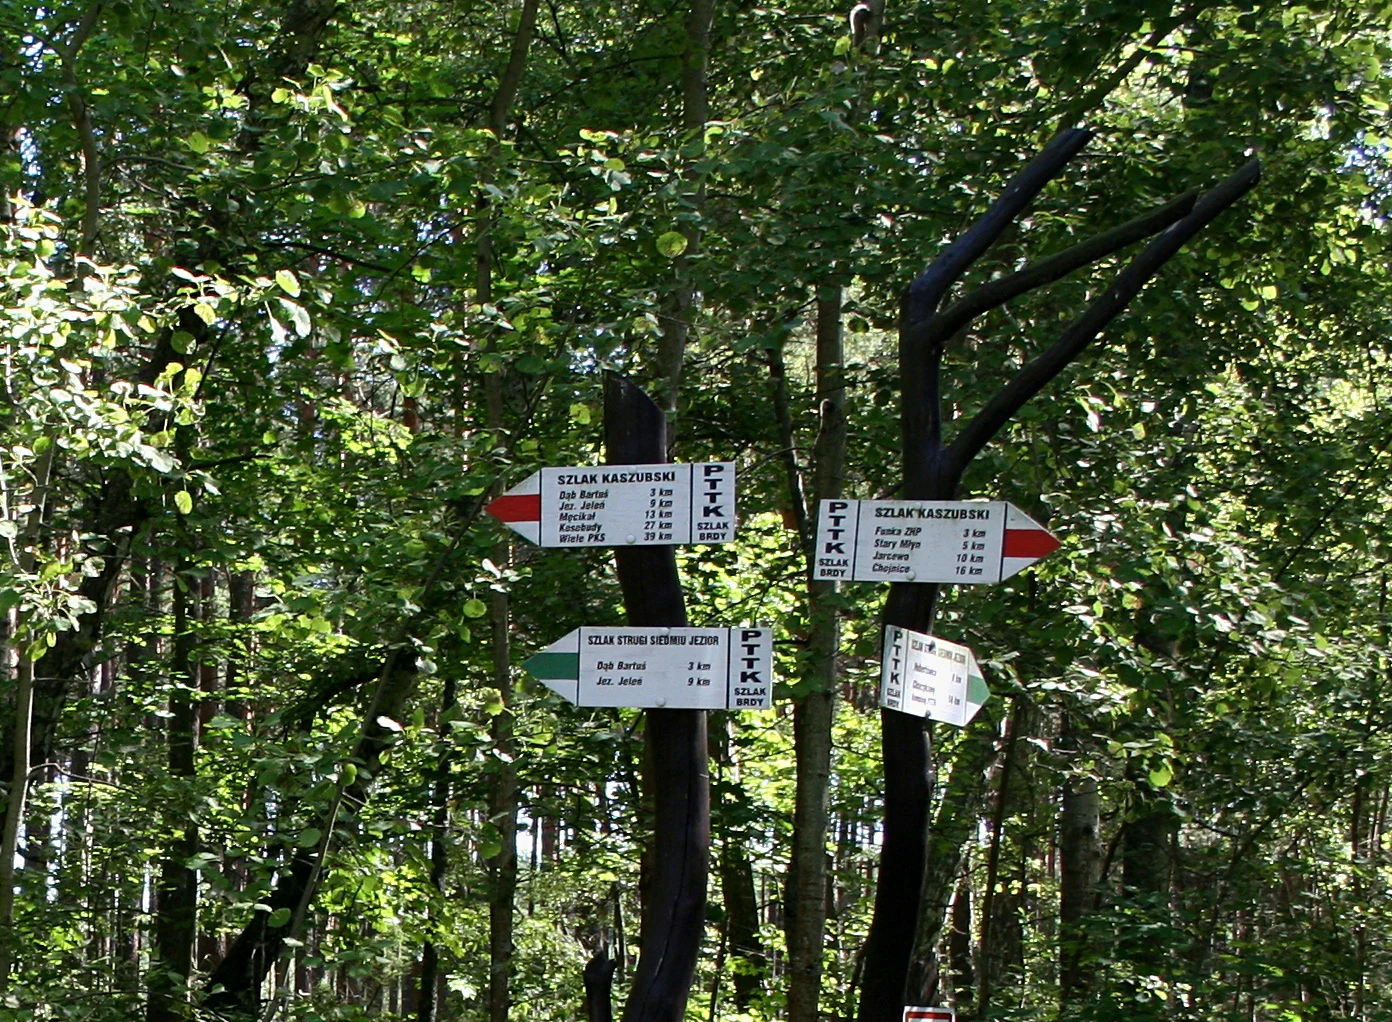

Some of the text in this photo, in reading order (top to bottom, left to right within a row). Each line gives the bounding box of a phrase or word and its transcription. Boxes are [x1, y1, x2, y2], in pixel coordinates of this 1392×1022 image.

[557, 472, 676, 485] SZLAK KASZUBSKI
[650, 499, 656, 508] 9
[658, 499, 673, 508] km
[644, 510, 655, 519] 13
[658, 510, 673, 519] km
[875, 507, 990, 520] SZLAK KASZUBSKI
[644, 521, 655, 530] 27
[658, 521, 673, 529] km
[697, 522, 729, 530] SZLAK
[559, 534, 585, 543] Wiele
[587, 534, 605, 542] PKS
[658, 532, 673, 540] km
[699, 533, 727, 541] BRDY
[972, 529, 986, 537] km
[874, 539, 896, 550] Stary
[971, 542, 985, 550] km
[819, 558, 849, 567] SZLAK
[956, 554, 967, 562] 10
[970, 555, 984, 563] km
[820, 569, 846, 577] BRDY
[955, 566, 966, 574] 16
[969, 567, 983, 575] km
[588, 635, 614, 645] SZLAK
[617, 635, 647, 645] STRUGI
[688, 635, 719, 645] JEZIOR
[596, 661, 711, 672] Dąb Bartuś 3 km
[596, 676, 615, 686] Jez.
[688, 677, 694, 686] 9
[696, 677, 710, 686] km
[734, 687, 766, 696] SZLAK
[736, 698, 763, 706] BRDY
